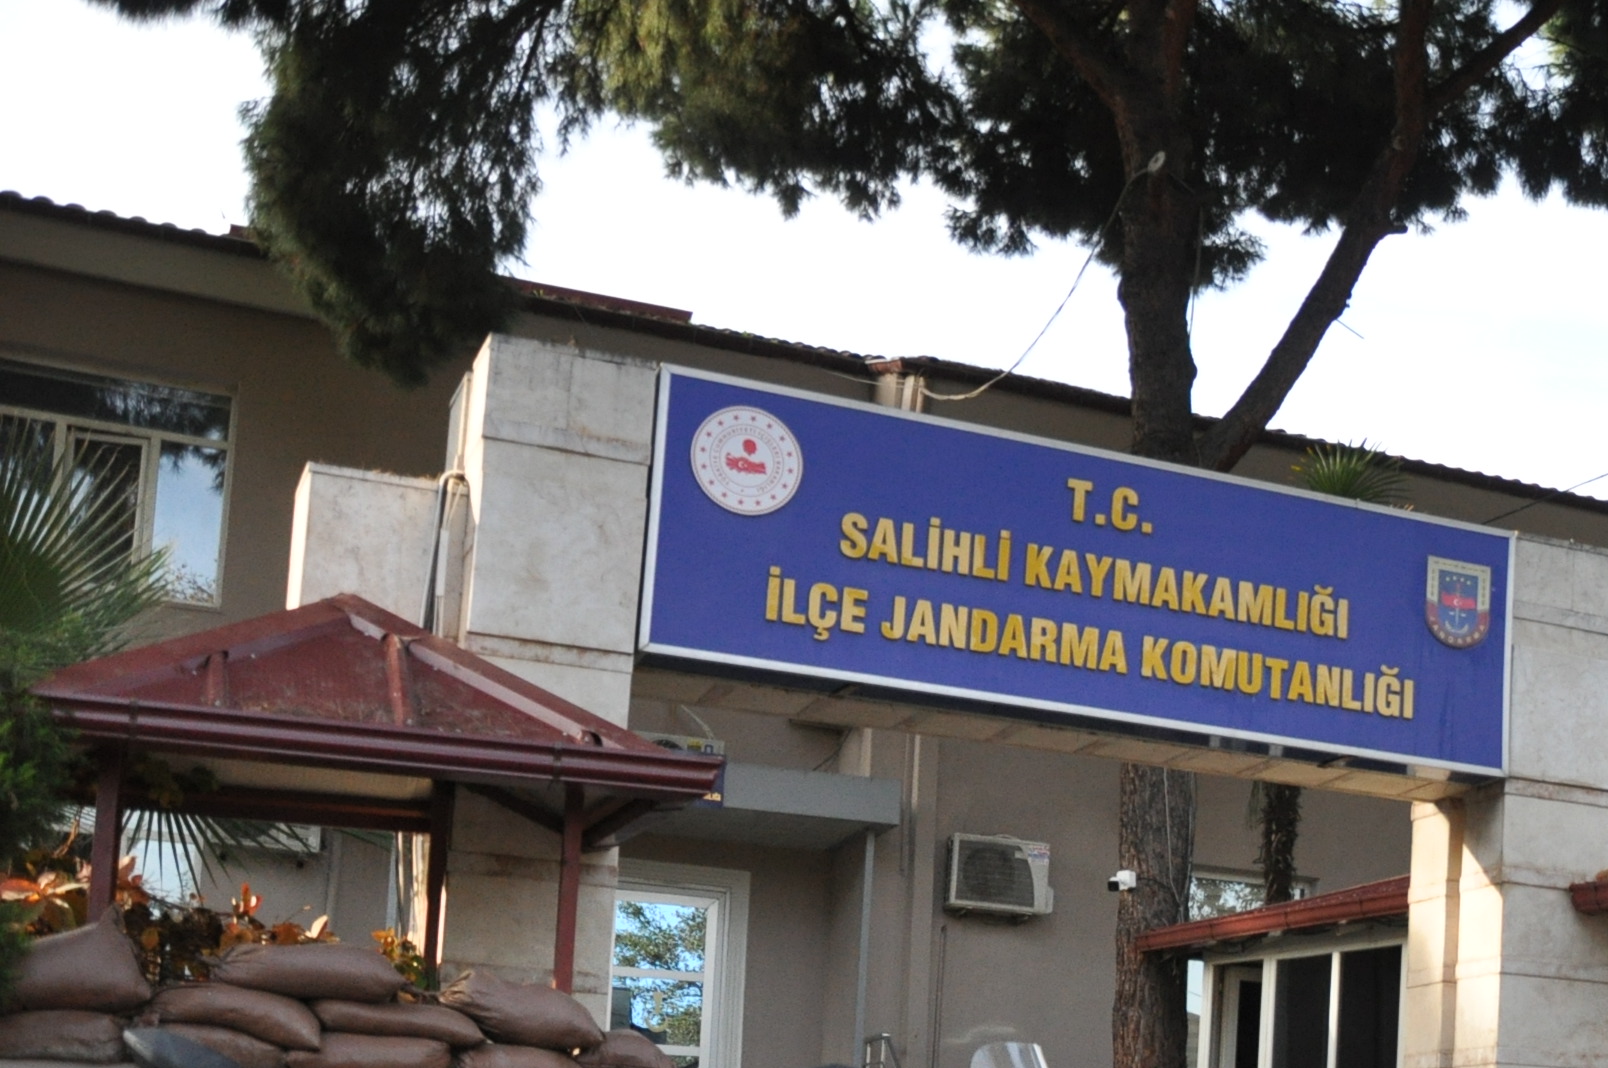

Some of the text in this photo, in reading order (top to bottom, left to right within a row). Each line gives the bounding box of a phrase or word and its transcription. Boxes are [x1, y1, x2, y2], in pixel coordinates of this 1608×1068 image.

[1068, 478, 1153, 534] T.C.
[840, 513, 1348, 638] SALİHLİ KAYMAKAMLIĞI
[766, 566, 1413, 718] İLÇE JANDARMA KOMUTANLIĞI
